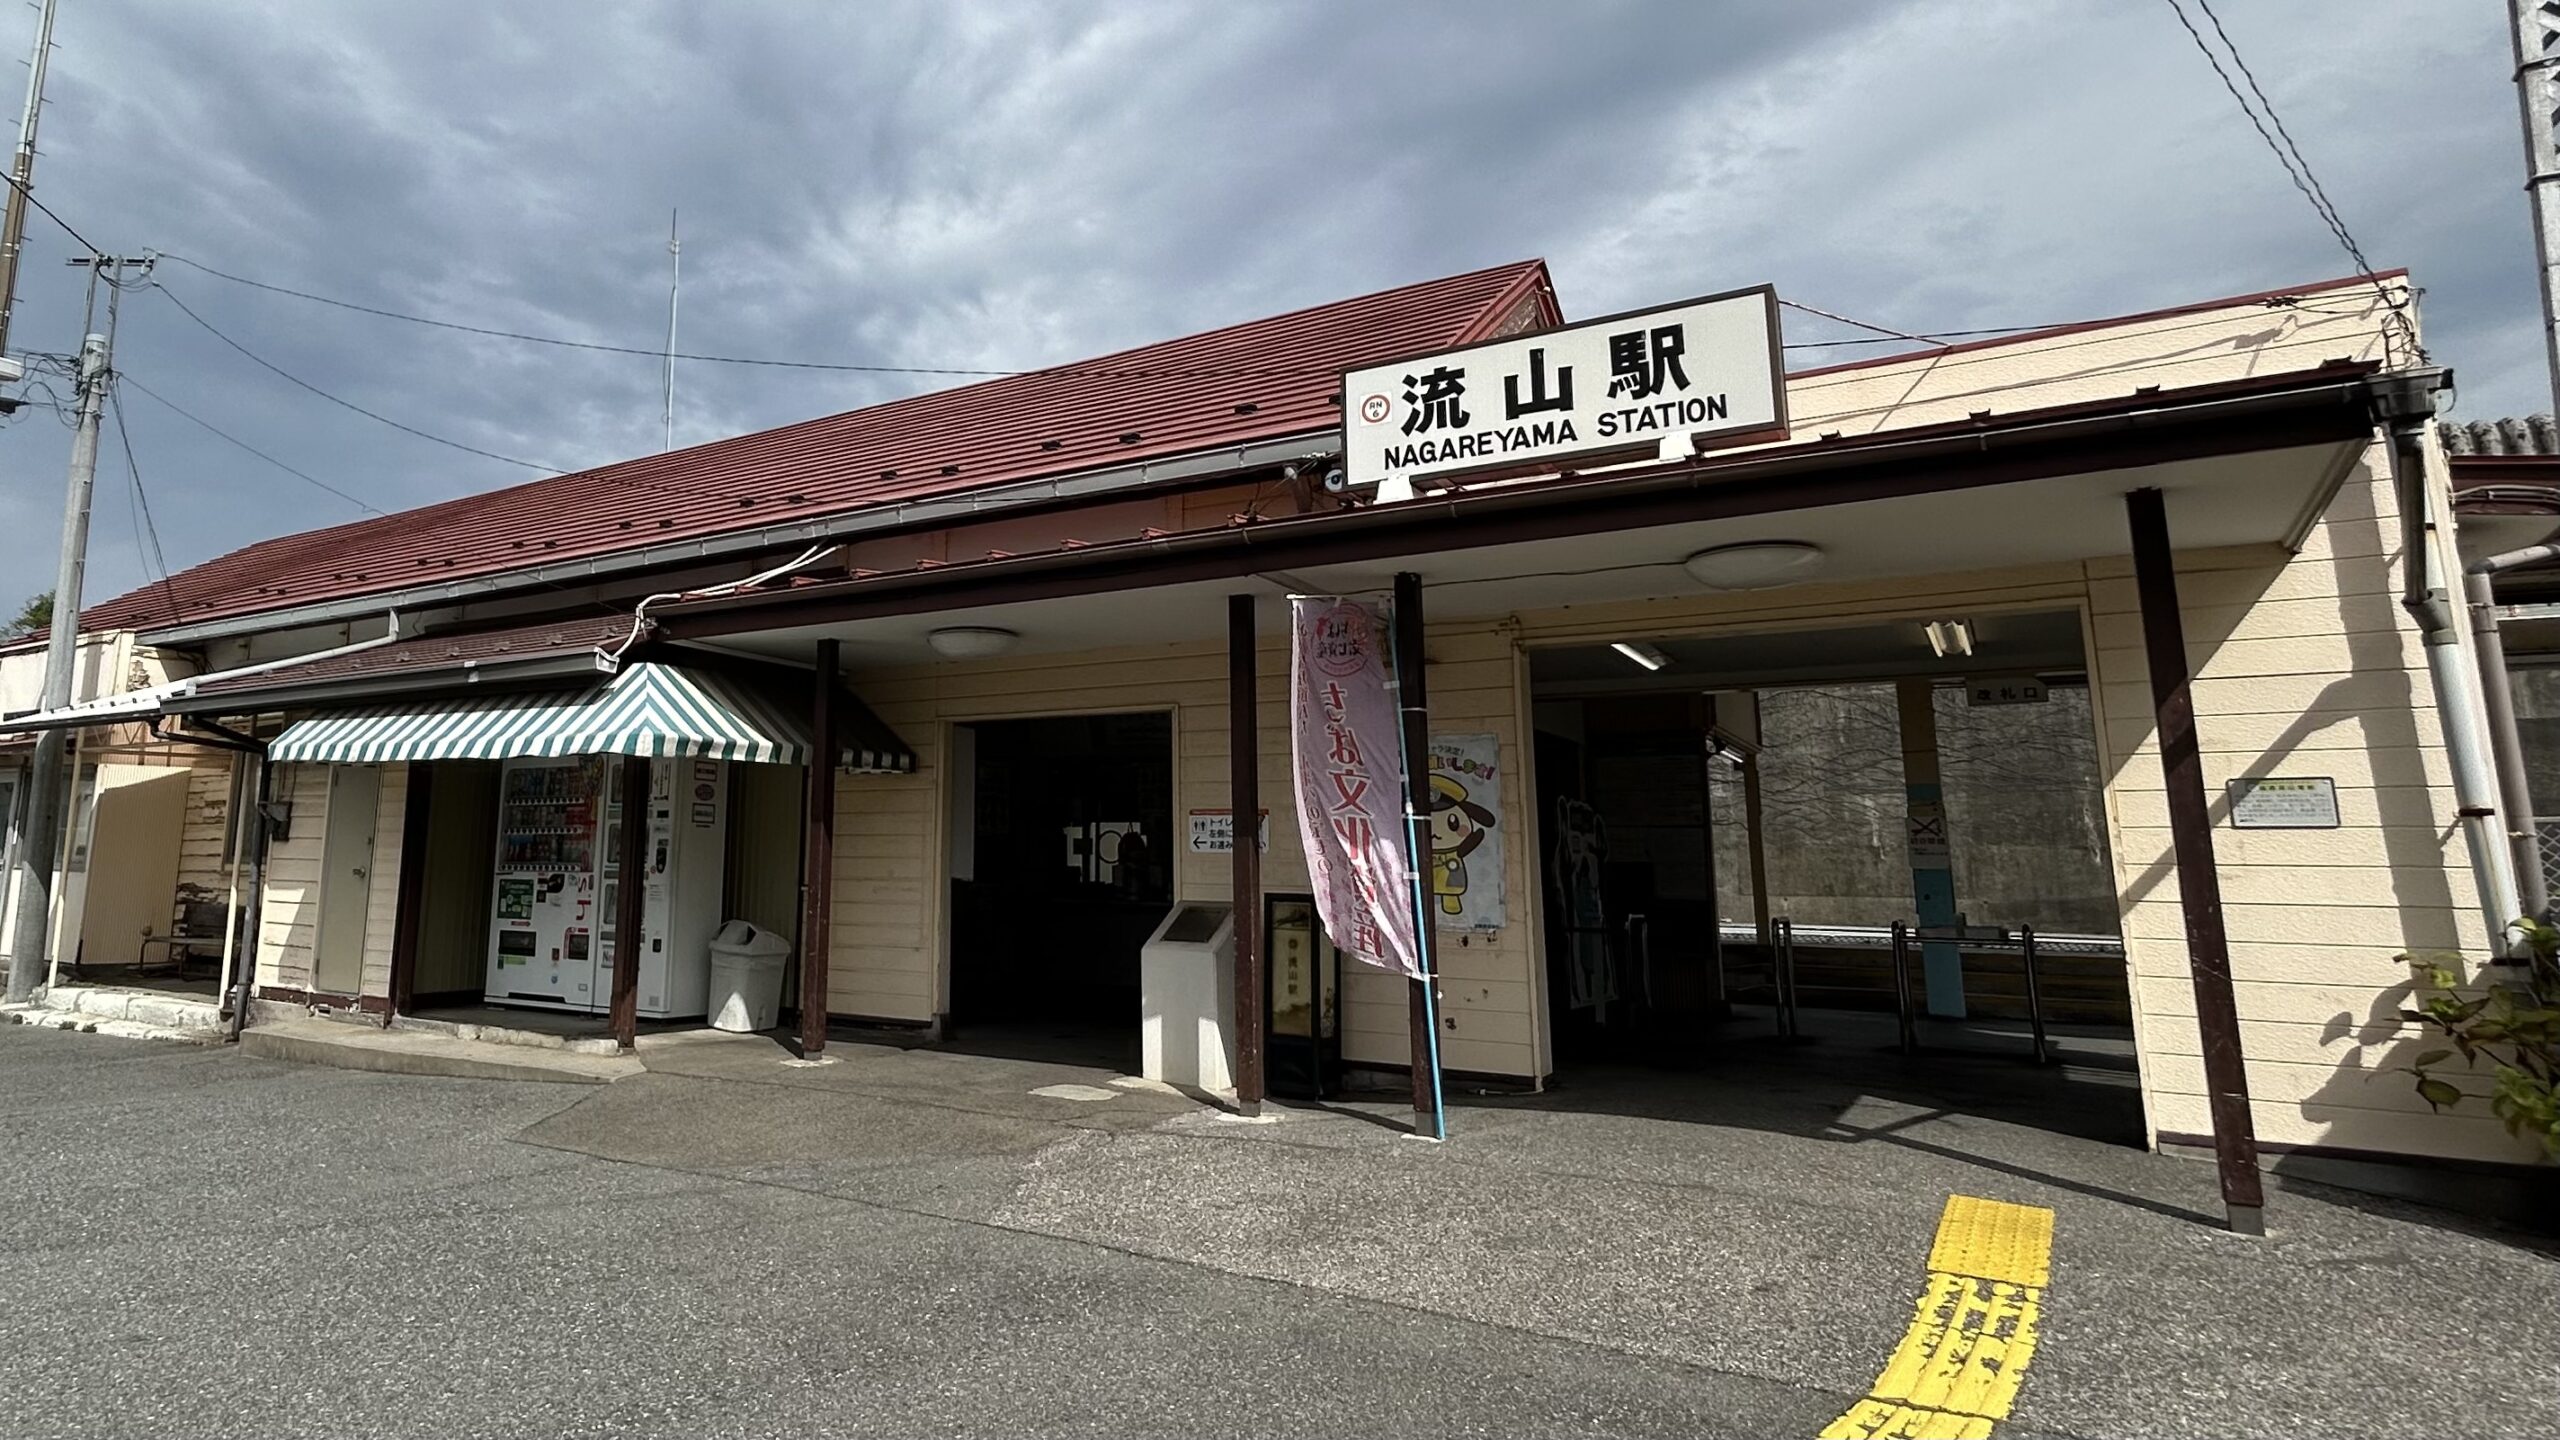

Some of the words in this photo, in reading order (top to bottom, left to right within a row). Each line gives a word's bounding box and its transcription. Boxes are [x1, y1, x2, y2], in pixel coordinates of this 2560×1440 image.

[1401, 323, 1690, 437] 流山駅
[1372, 409, 1380, 418] 6
[1384, 419, 1578, 471] NAGAREYAMA
[1596, 393, 1728, 437] STATION
[1976, 687, 2037, 700] 改札口
